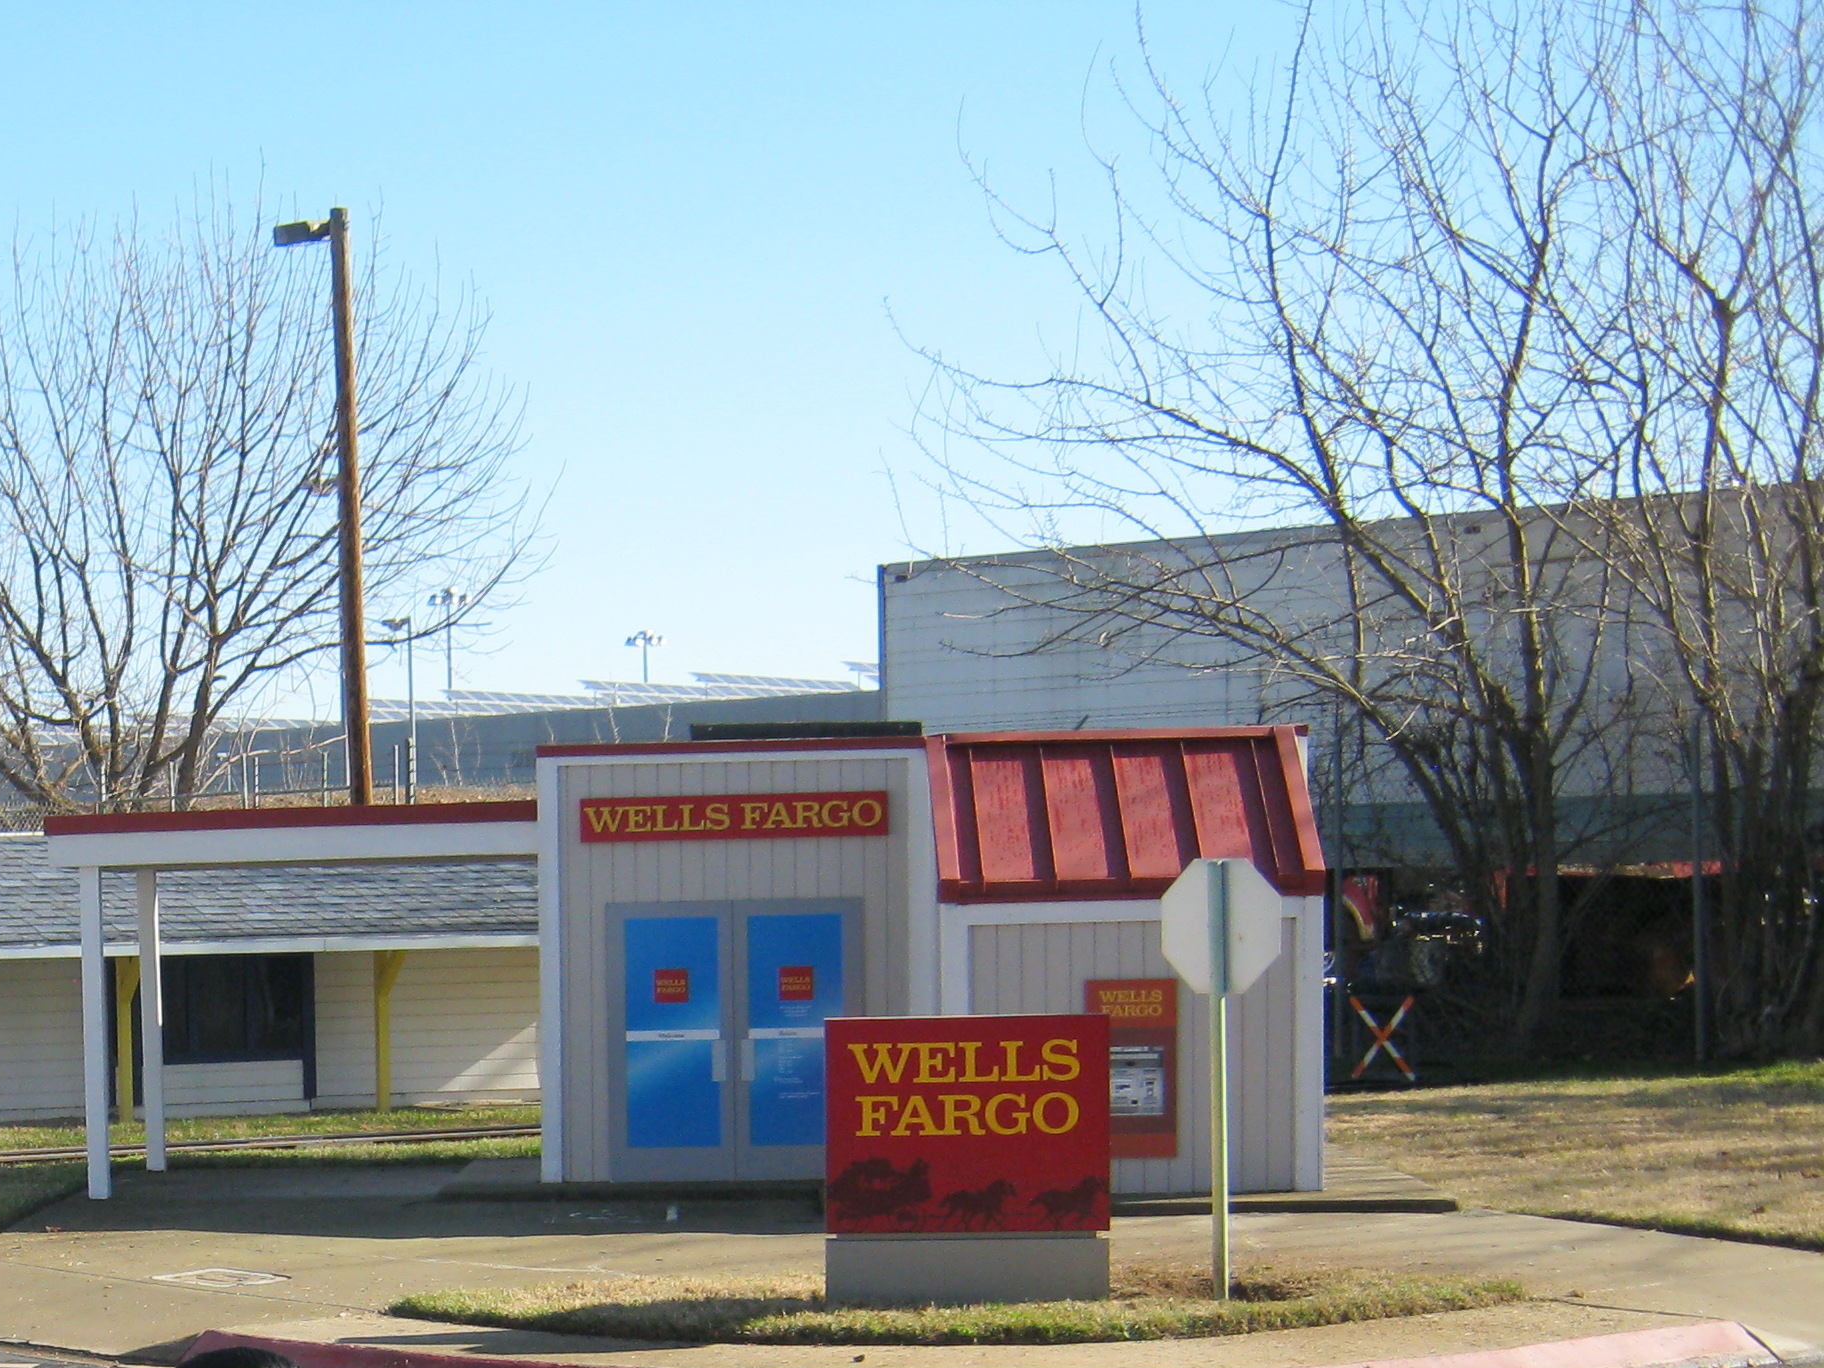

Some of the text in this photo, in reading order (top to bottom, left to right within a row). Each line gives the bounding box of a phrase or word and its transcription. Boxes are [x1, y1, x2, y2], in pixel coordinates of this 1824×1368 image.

[583, 799, 883, 833] WELLS FARGO
[1099, 989, 1163, 1003] WELLS
[1100, 1003, 1163, 1017] FARGO
[847, 1039, 1081, 1084] WELLS
[854, 1091, 1080, 1137] FARGO
